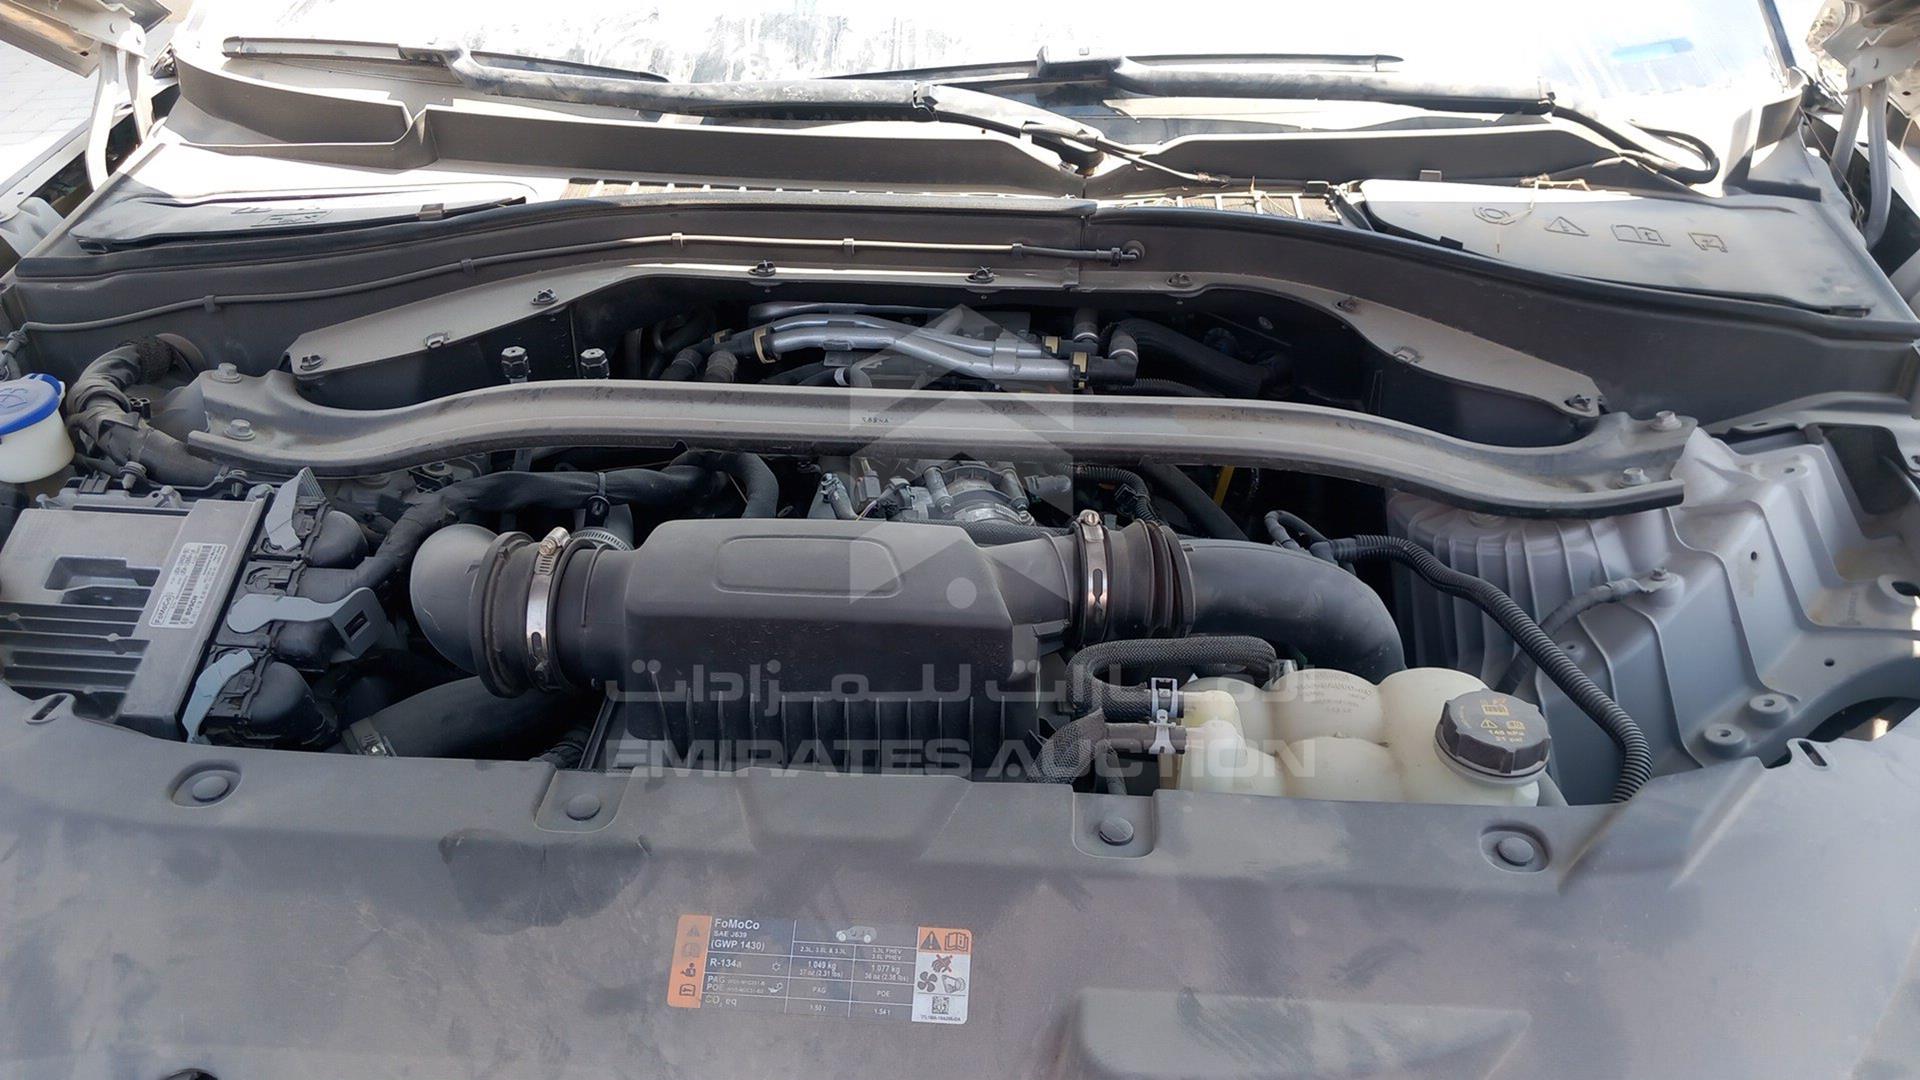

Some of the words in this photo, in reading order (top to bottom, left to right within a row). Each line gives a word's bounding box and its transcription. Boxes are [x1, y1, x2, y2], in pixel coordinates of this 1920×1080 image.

[714, 918, 760, 930] FoMoCo
[710, 939, 738, 949] (GWP
[740, 940, 766, 952] 1430)
[709, 958, 742, 969] R-134a
[808, 960, 827, 969] 1.049
[828, 961, 838, 970] kg
[891, 965, 901, 974] kg
[707, 975, 726, 984] PAG
[812, 986, 827, 994] PAG
[725, 998, 738, 1006] eq
